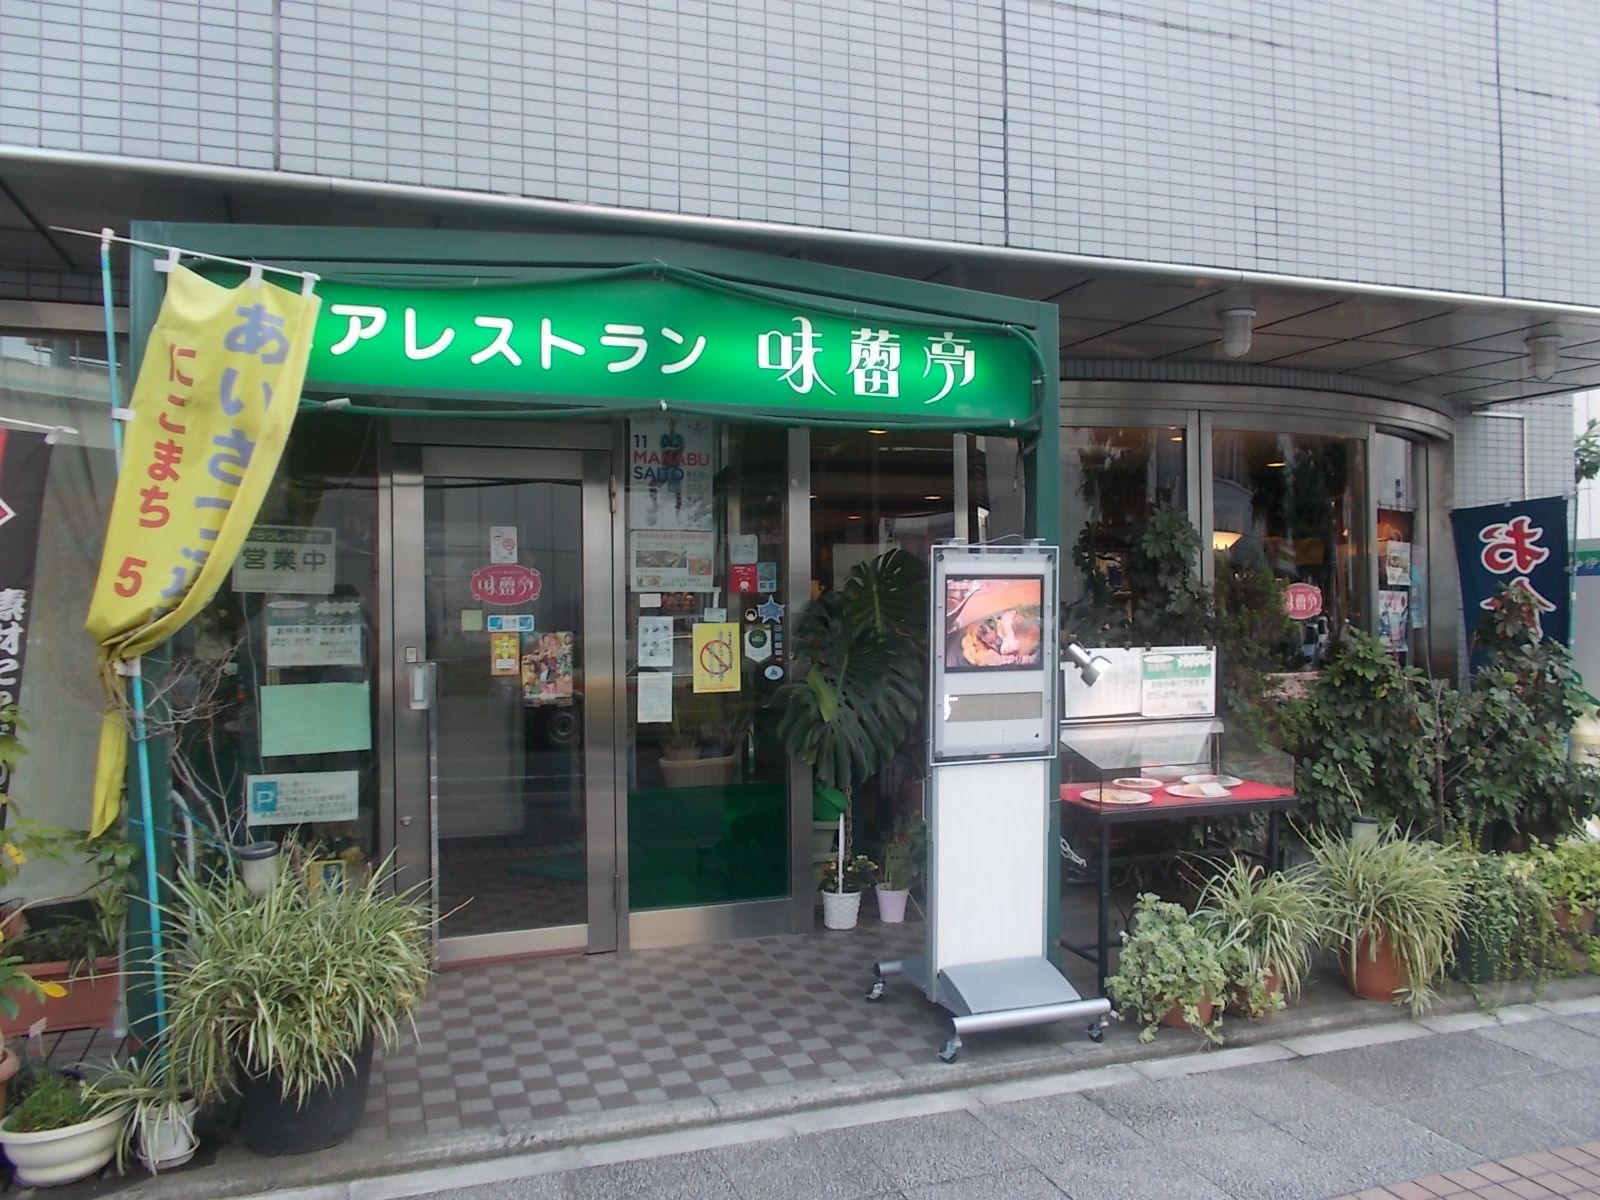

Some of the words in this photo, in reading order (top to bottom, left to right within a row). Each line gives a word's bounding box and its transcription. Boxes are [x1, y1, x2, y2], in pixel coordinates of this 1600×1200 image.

[311, 304, 707, 375] アレストラン
[757, 314, 977, 405] 味蕾亭
[633, 433, 648, 448] 11
[632, 449, 710, 466] MANABU
[243, 546, 327, 572] 営業中
